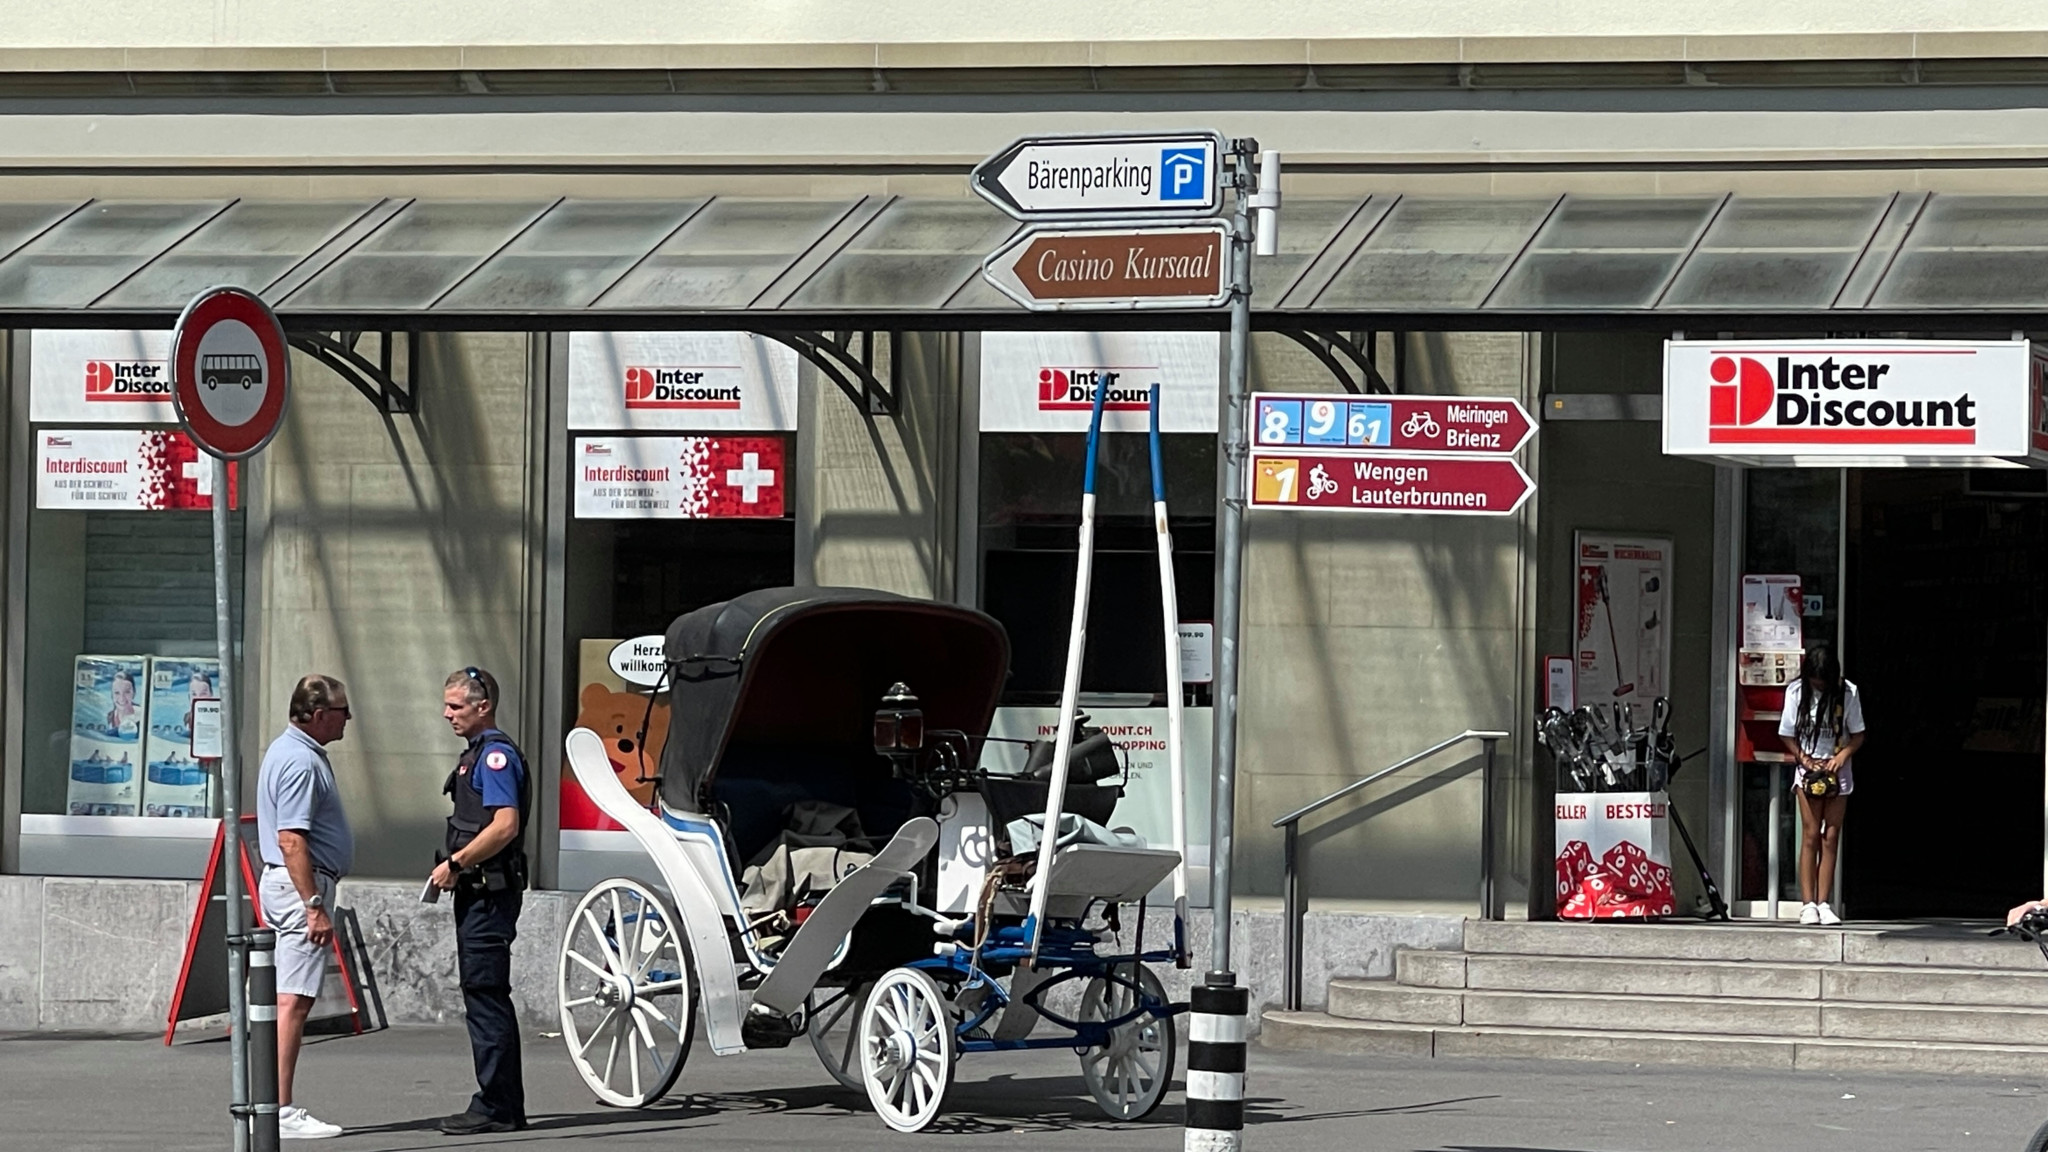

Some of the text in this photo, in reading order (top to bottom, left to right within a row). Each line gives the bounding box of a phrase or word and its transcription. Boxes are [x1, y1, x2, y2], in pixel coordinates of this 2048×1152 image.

[1028, 157, 1152, 197] Bärenparking
[1174, 164, 1192, 194] P
[1038, 244, 1214, 282] Casino Kursaal
[114, 362, 160, 378] Inter
[656, 369, 703, 385] Inter
[1777, 356, 1890, 390] Inter
[656, 385, 741, 400] Discount
[1308, 401, 1336, 436] 9
[1447, 405, 1508, 428] Meiringen
[1776, 393, 1976, 427] Discount
[1261, 411, 1289, 444] 8
[1447, 429, 1501, 448] Brienz
[46, 457, 128, 473] Interdiscount
[585, 465, 670, 481] Interdiscount
[1354, 462, 1428, 484] Wengen
[54, 480, 67, 488] AUS
[593, 488, 606, 497] AUS
[609, 488, 622, 497] DER
[624, 488, 654, 497] SCHWEIZ
[1276, 468, 1296, 502] 1
[638, 500, 670, 509] SCHWEIZ
[1352, 486, 1487, 507] Lauterbrunnen
